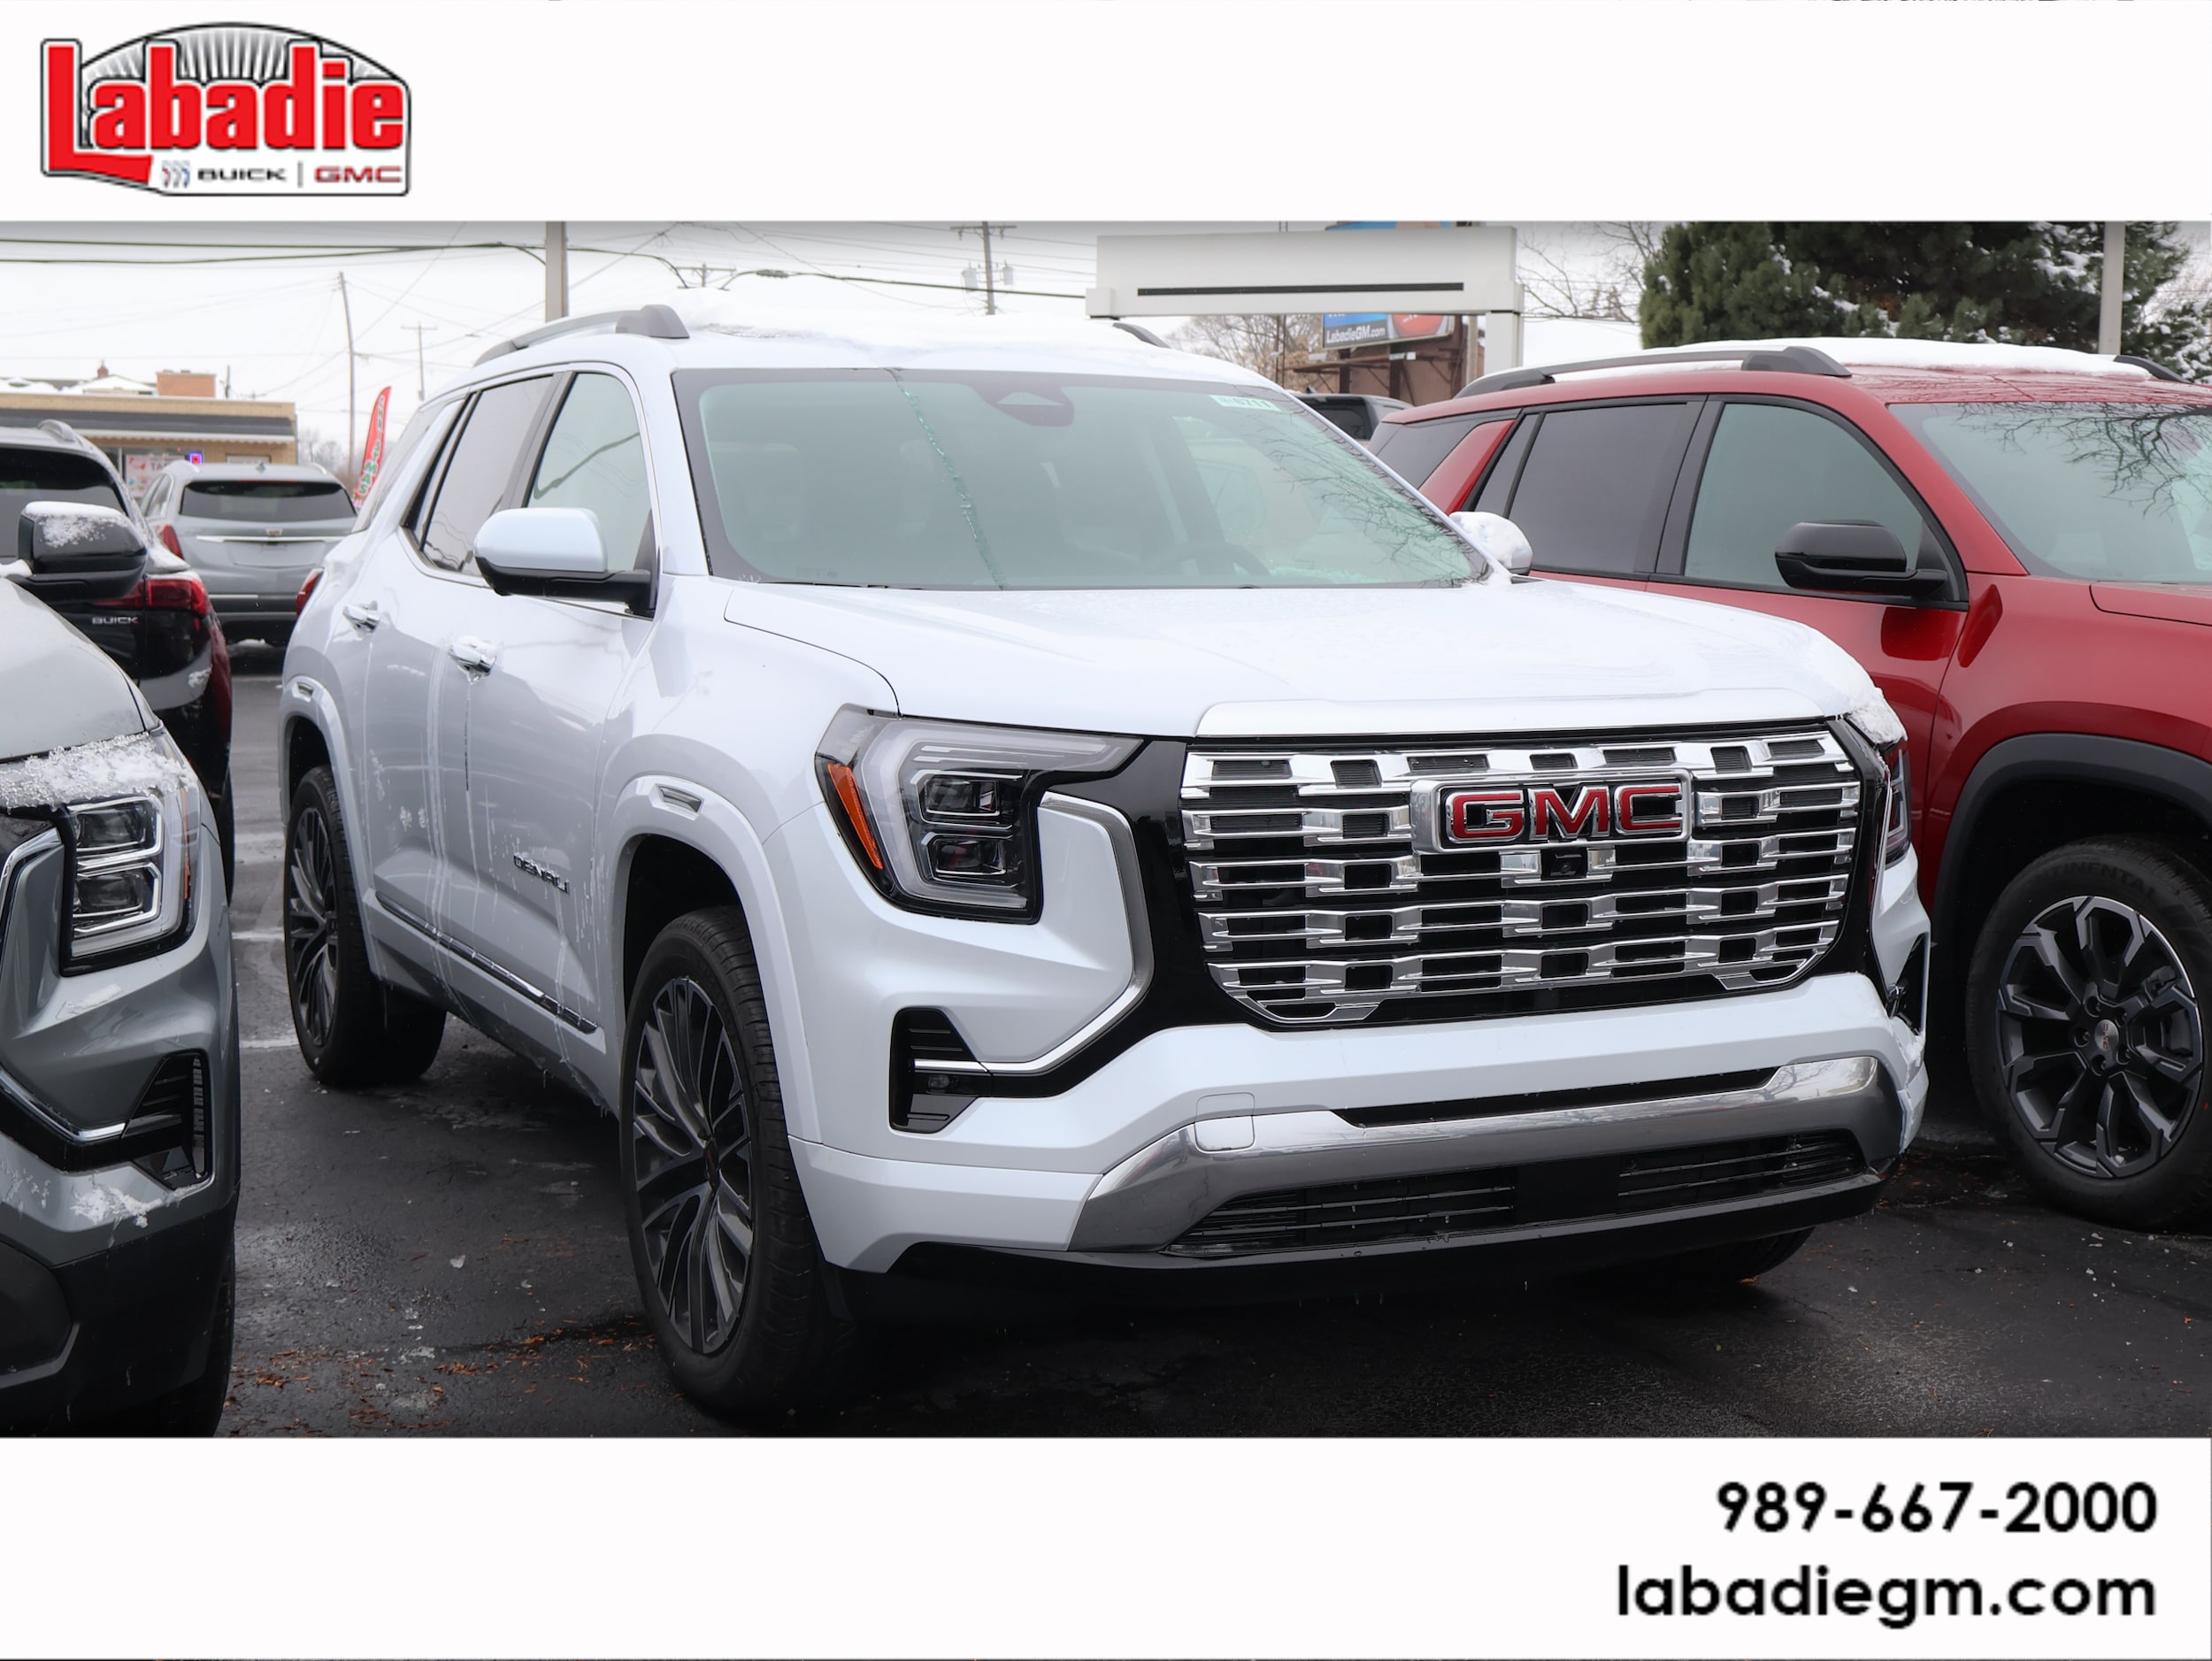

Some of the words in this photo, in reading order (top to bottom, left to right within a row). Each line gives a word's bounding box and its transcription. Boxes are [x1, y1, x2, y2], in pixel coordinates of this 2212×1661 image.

[91, 616, 139, 625] BUICK
[1445, 784, 1681, 842] GMC
[513, 854, 570, 895] DENALI
